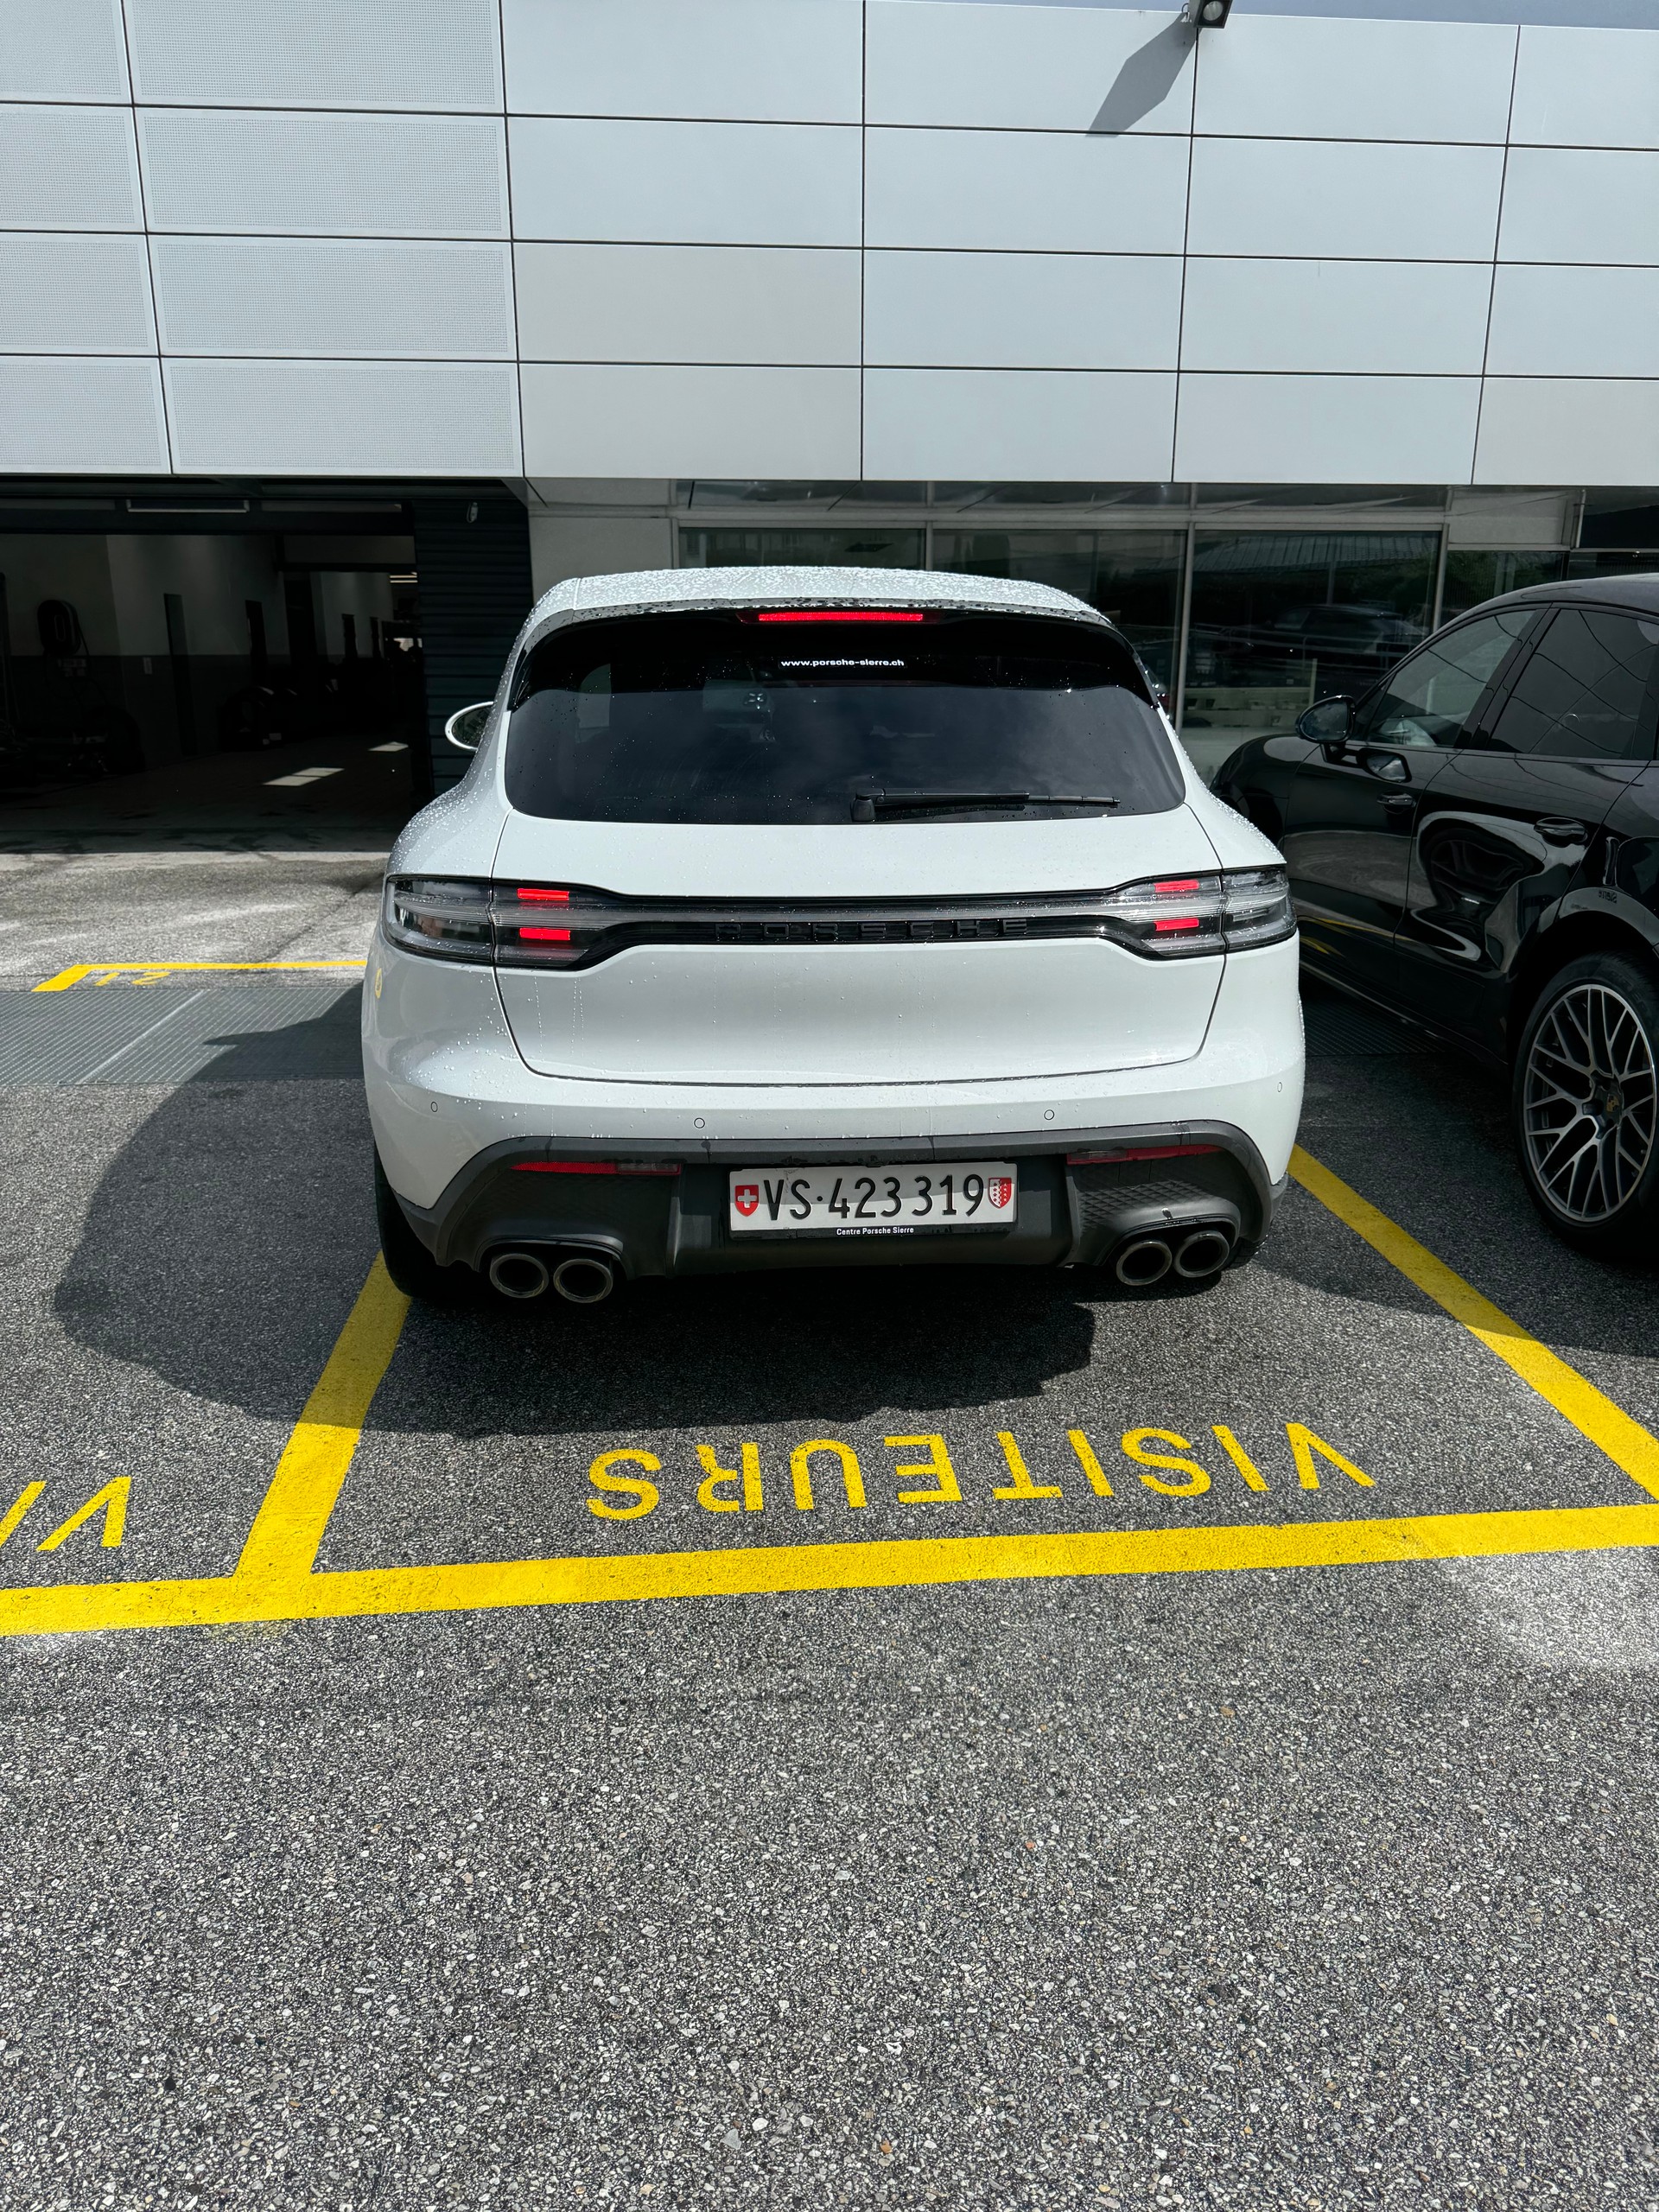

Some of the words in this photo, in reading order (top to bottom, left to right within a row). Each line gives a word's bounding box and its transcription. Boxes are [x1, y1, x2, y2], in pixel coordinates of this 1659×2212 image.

[780, 658, 905, 668] www.porsche-sierre.ch
[715, 918, 1028, 940] PORSCHE
[836, 1228, 861, 1236] Centre
[862, 1227, 891, 1236] Porsche
[893, 1226, 914, 1235] Sierre
[586, 1421, 1376, 1522] VISITEURS
